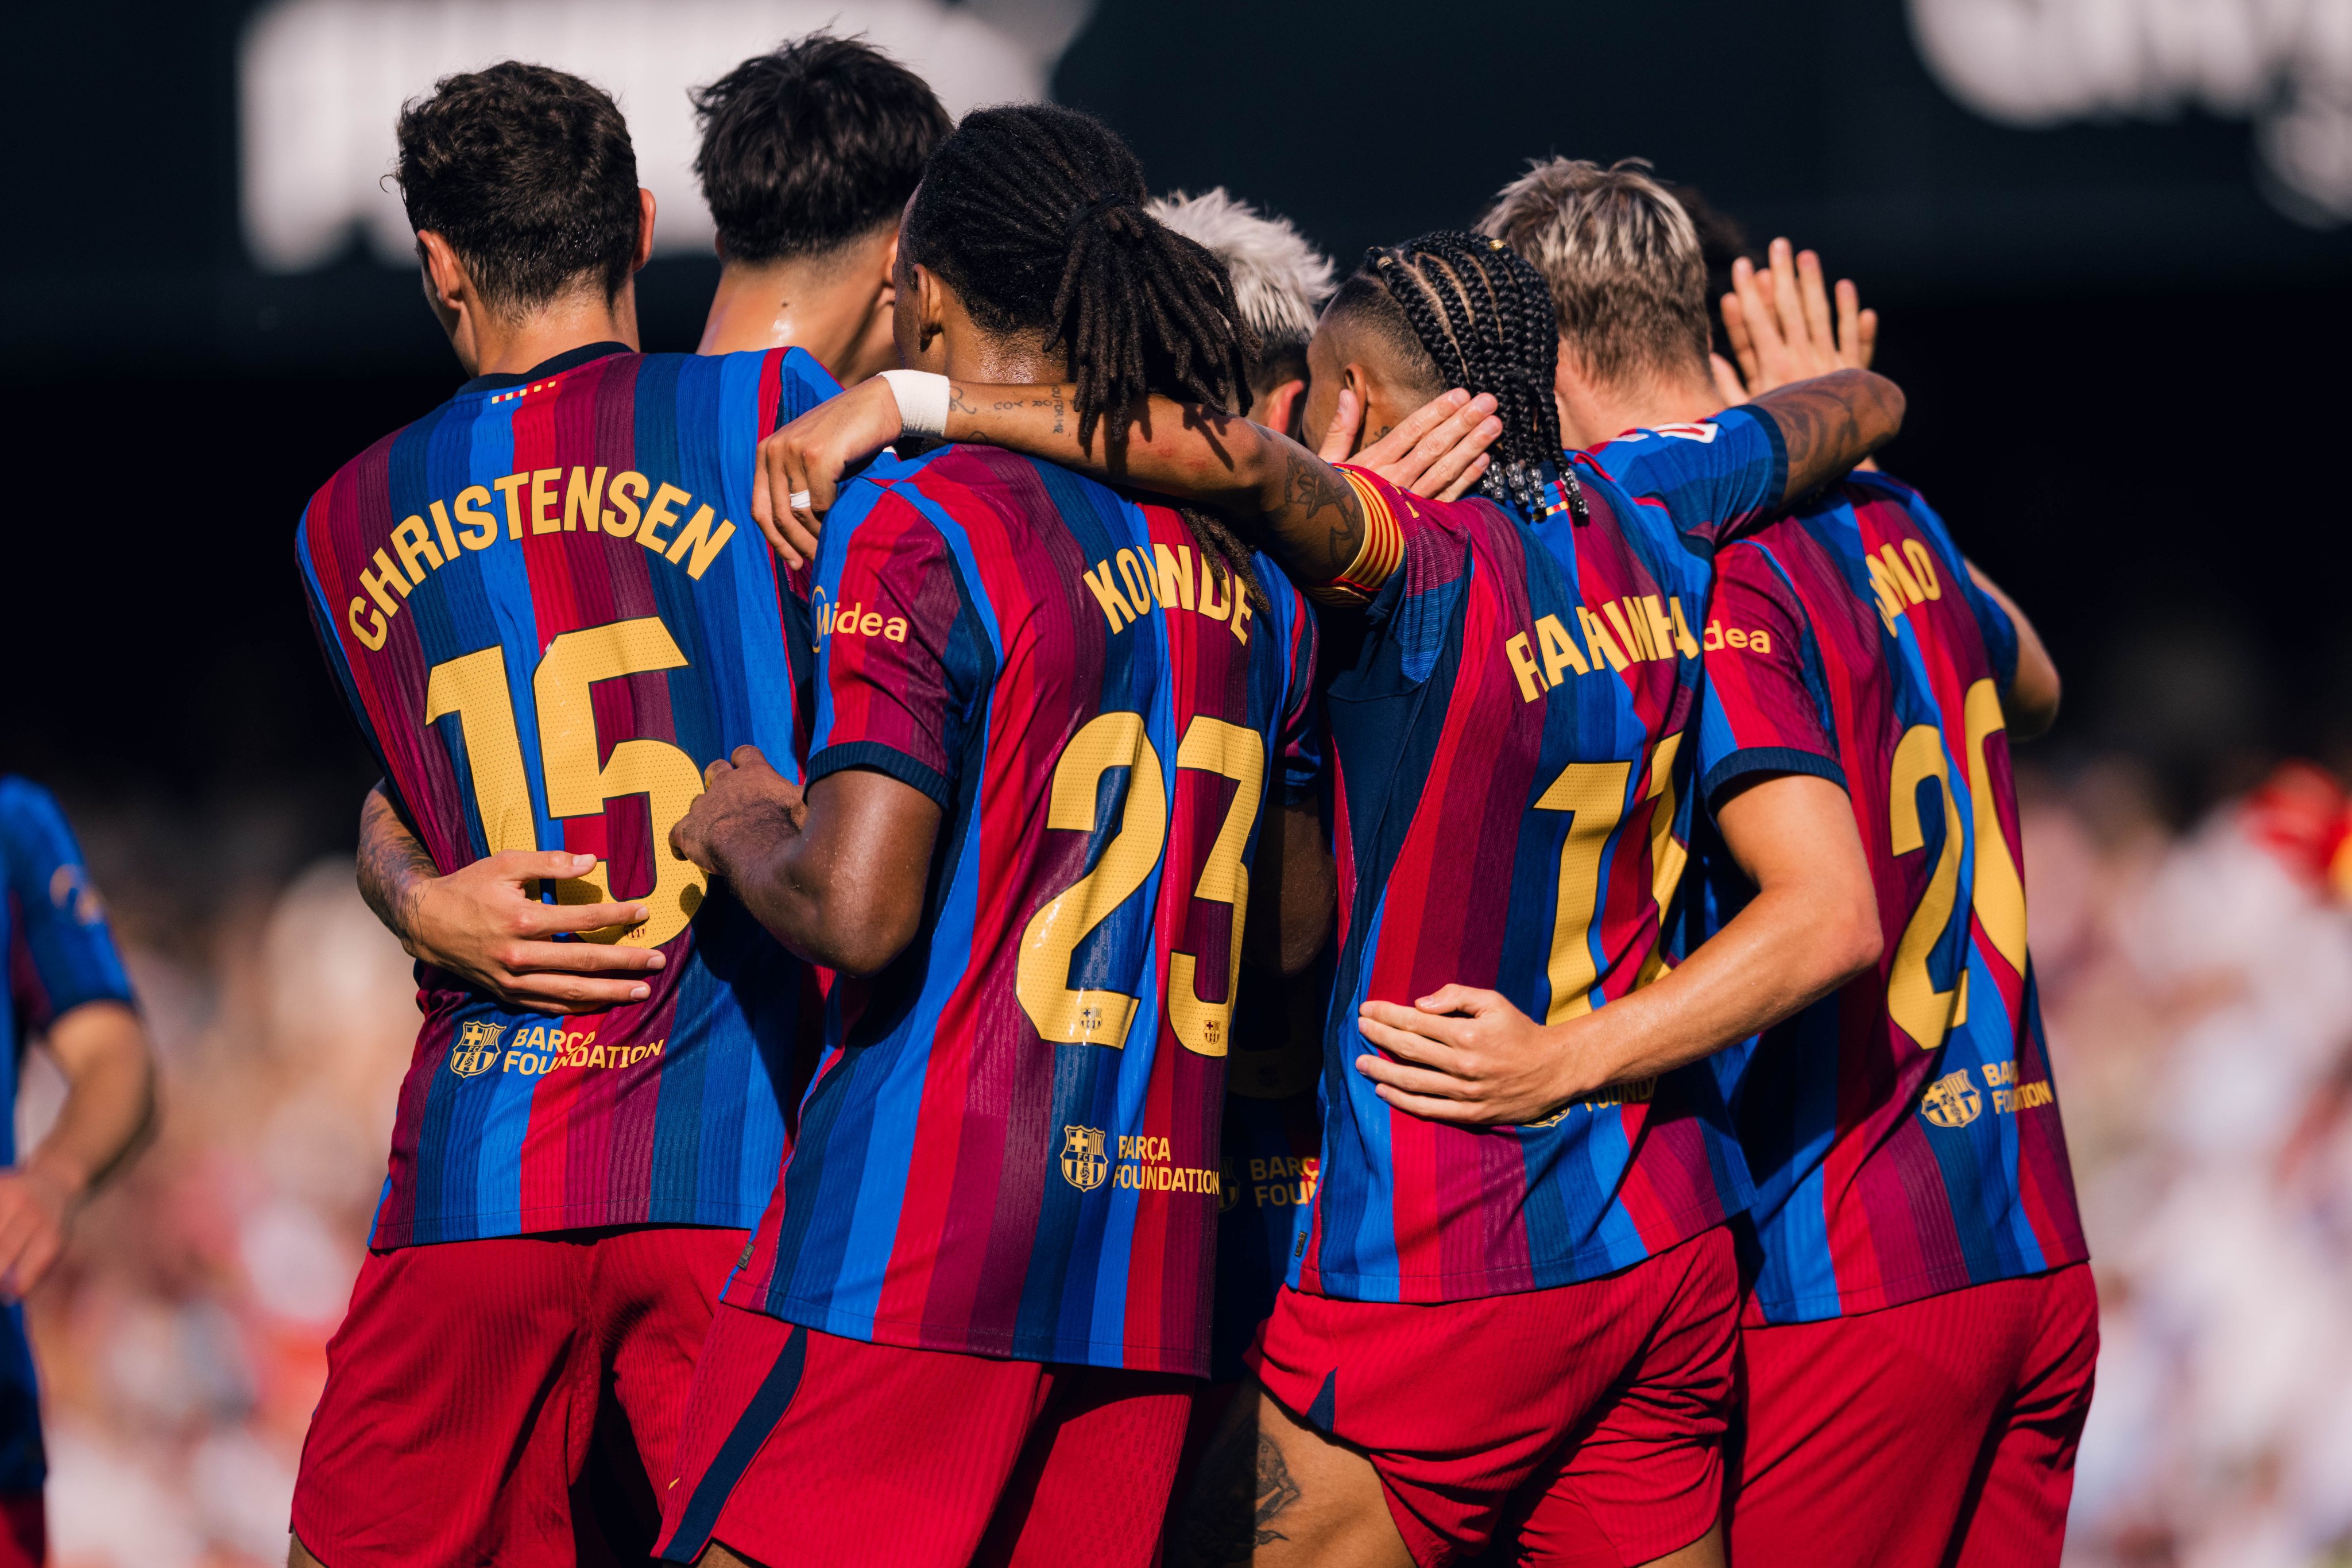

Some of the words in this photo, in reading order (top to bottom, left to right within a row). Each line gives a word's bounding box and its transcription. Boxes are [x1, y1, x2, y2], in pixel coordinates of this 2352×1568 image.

[348, 466, 736, 651] CHRISTENSEN
[813, 598, 908, 644] Midea
[1703, 620, 1770, 653] dea
[426, 616, 707, 948] 15
[1016, 711, 1263, 1058] 23
[503, 1039, 664, 1075] FOUNDATION
[512, 1027, 595, 1055] BARÇA
[1077, 1152, 1094, 1163] FCB
[1119, 1136, 1171, 1164] BARÇA
[1113, 1166, 1219, 1195] FOUNDATION
[1250, 1157, 1320, 1182] BARÇ
